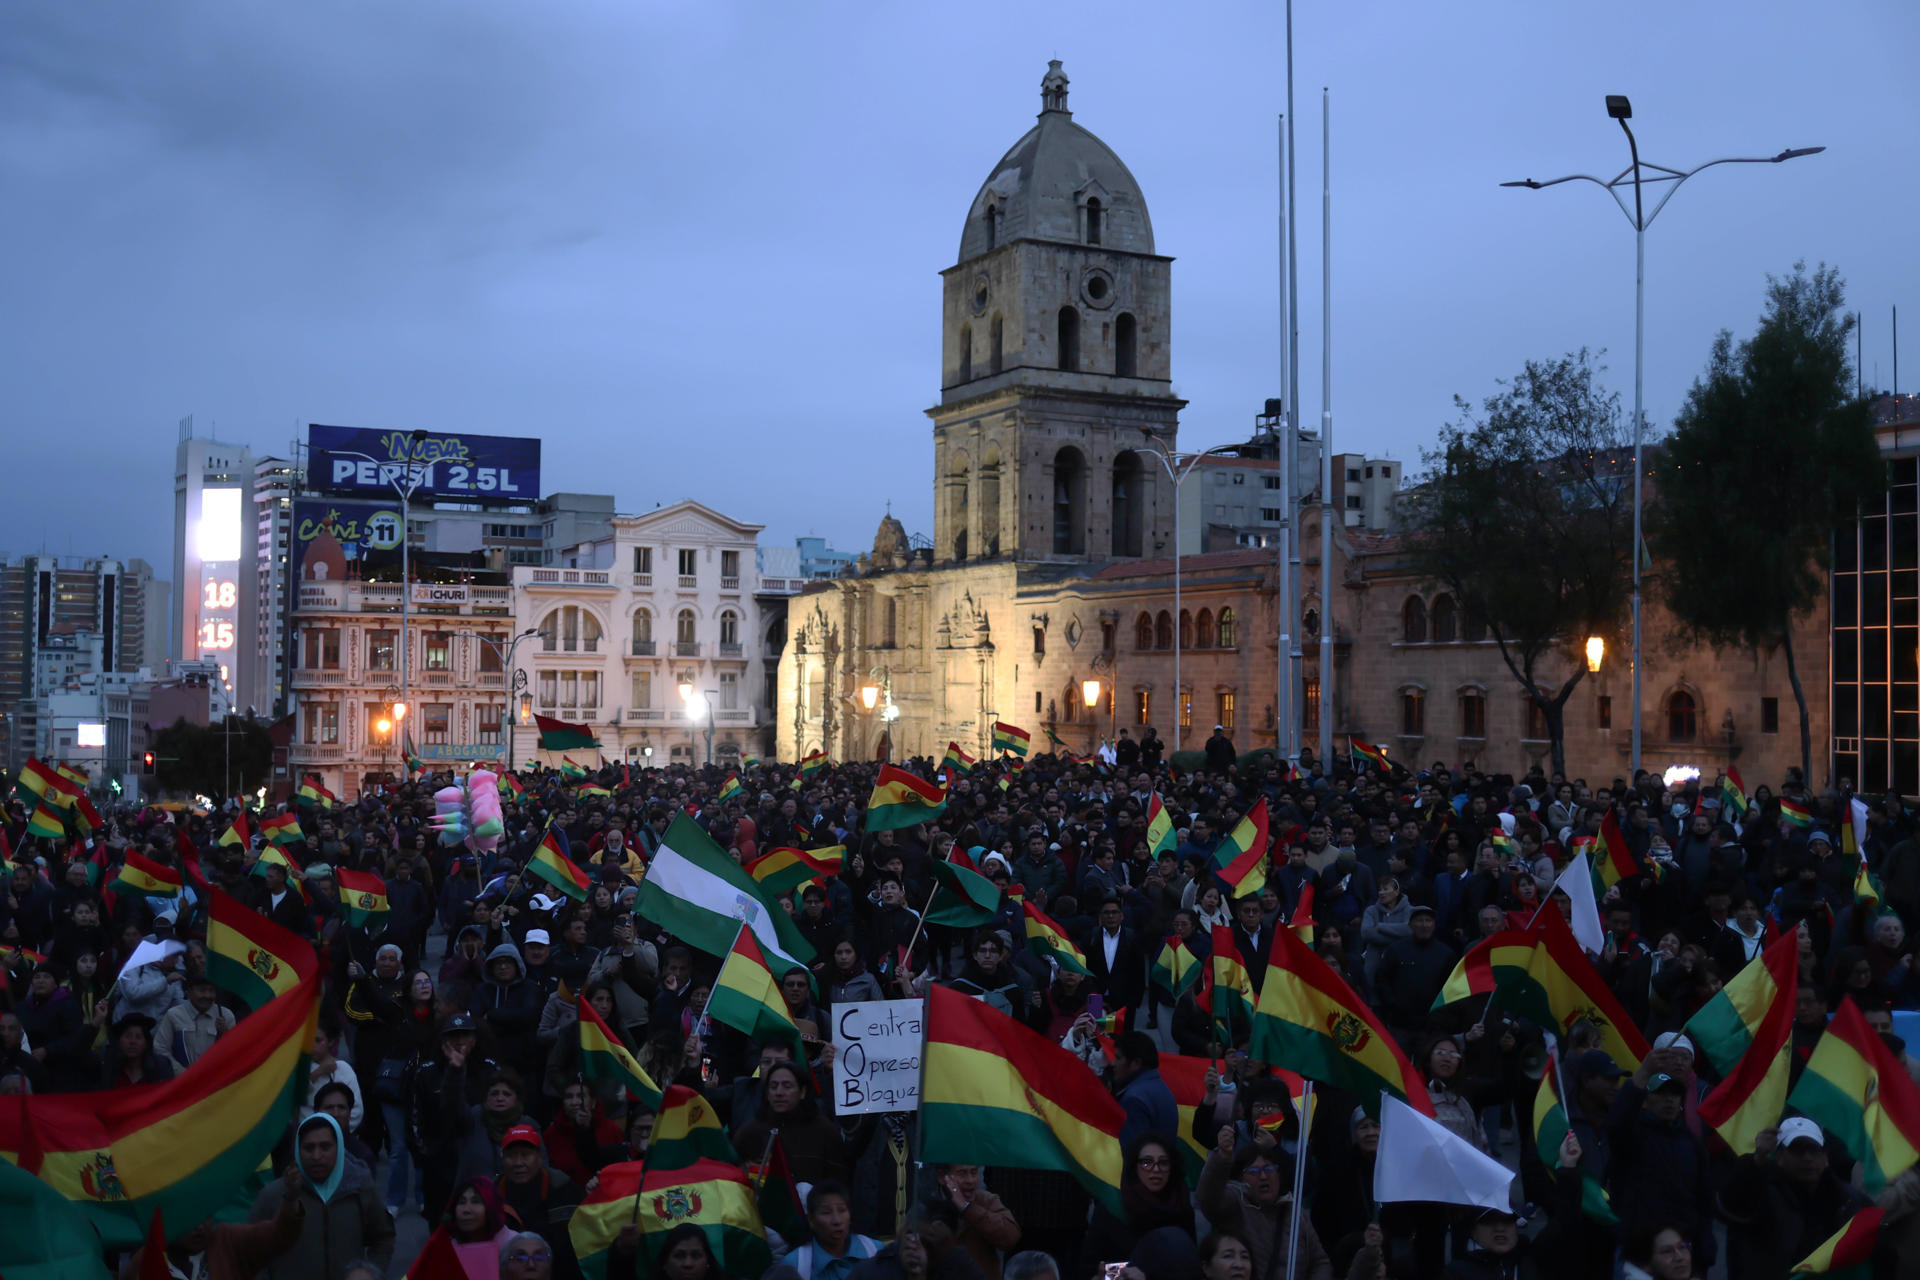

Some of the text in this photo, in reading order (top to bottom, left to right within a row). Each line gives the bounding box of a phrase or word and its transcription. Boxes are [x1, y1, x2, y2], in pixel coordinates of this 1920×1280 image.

[332, 460, 519, 492] PEPSI 2.5L
[375, 524, 395, 541] 11
[204, 580, 236, 610] 18
[437, 745, 497, 757] ABOGADO
